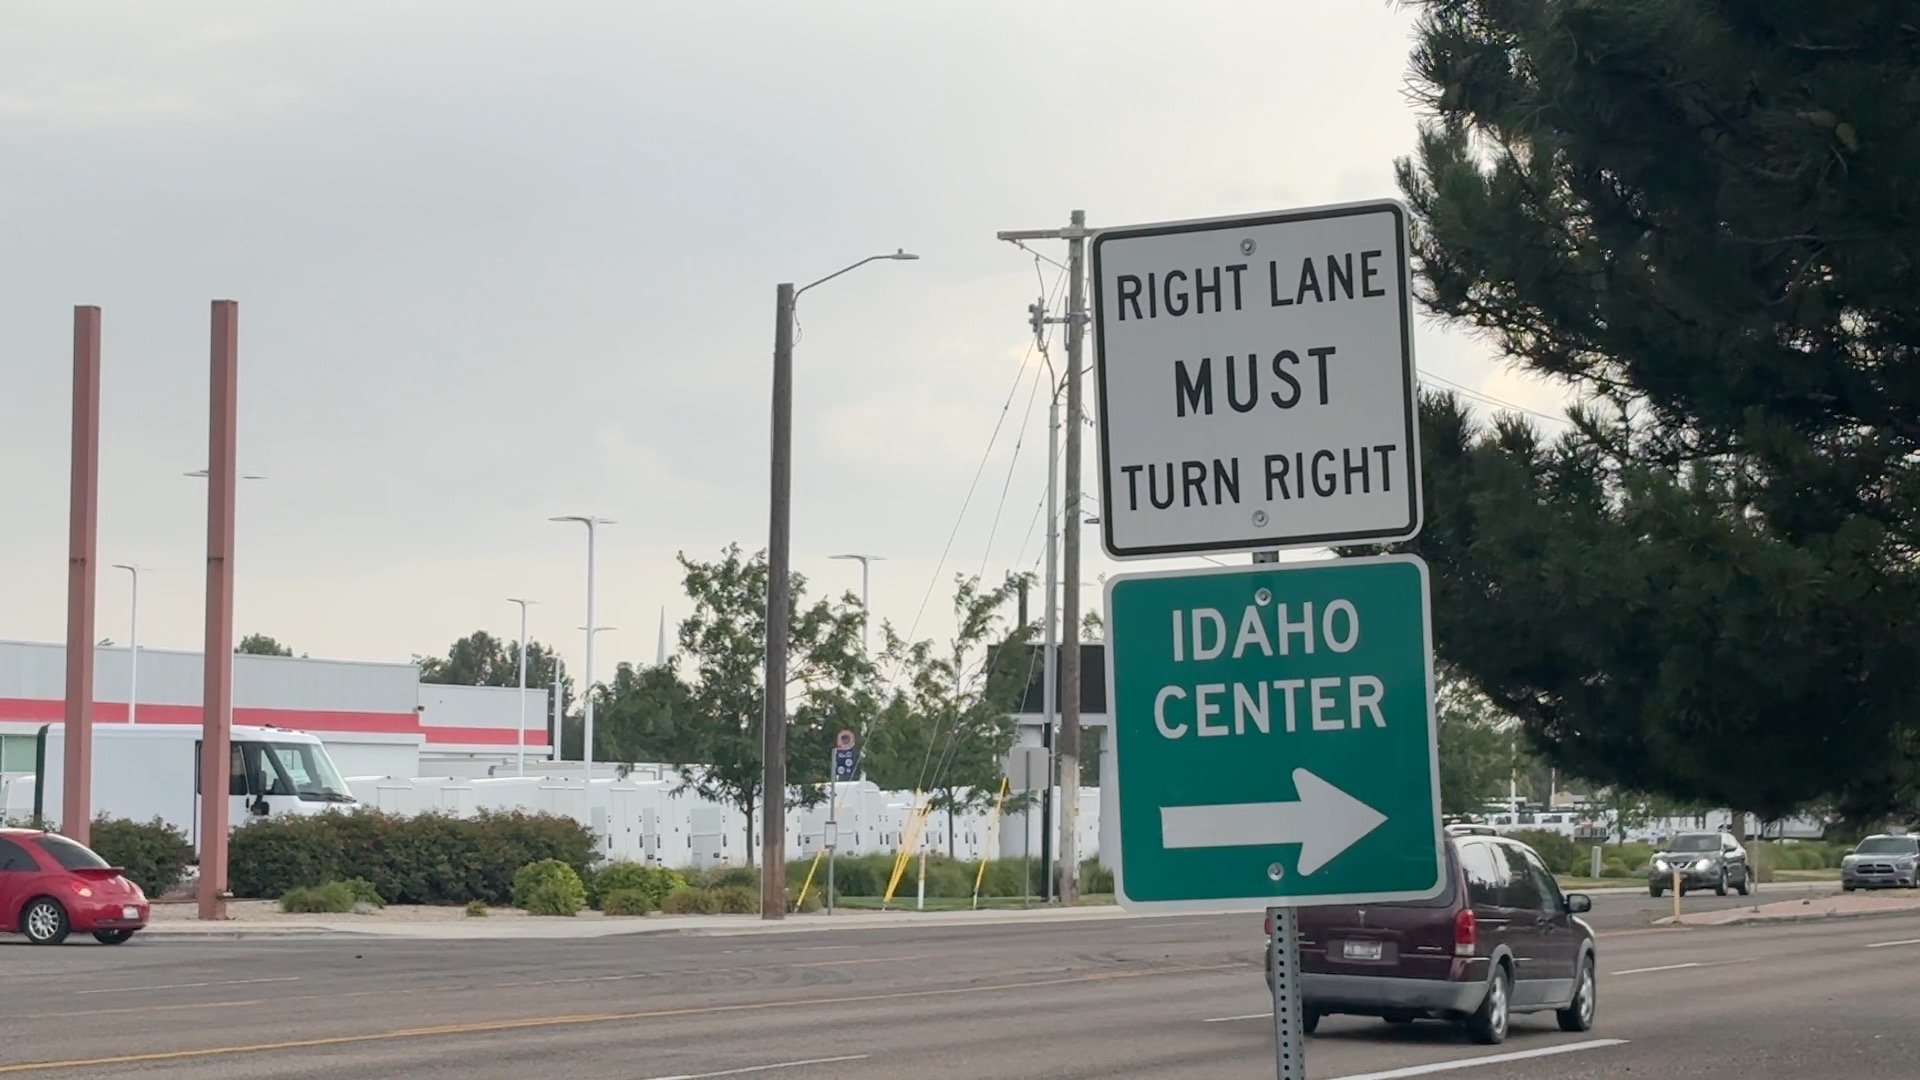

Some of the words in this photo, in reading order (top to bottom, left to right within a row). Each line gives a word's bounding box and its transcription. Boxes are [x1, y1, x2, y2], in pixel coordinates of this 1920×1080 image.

[1117, 263, 1248, 321] RIGHT
[1269, 250, 1386, 307] LANE
[1175, 346, 1336, 417] MUST
[1121, 457, 1240, 511] TURN
[1264, 444, 1396, 501] RIGHT
[1172, 599, 1360, 662] IDAHO
[1153, 675, 1387, 740] CENTER
